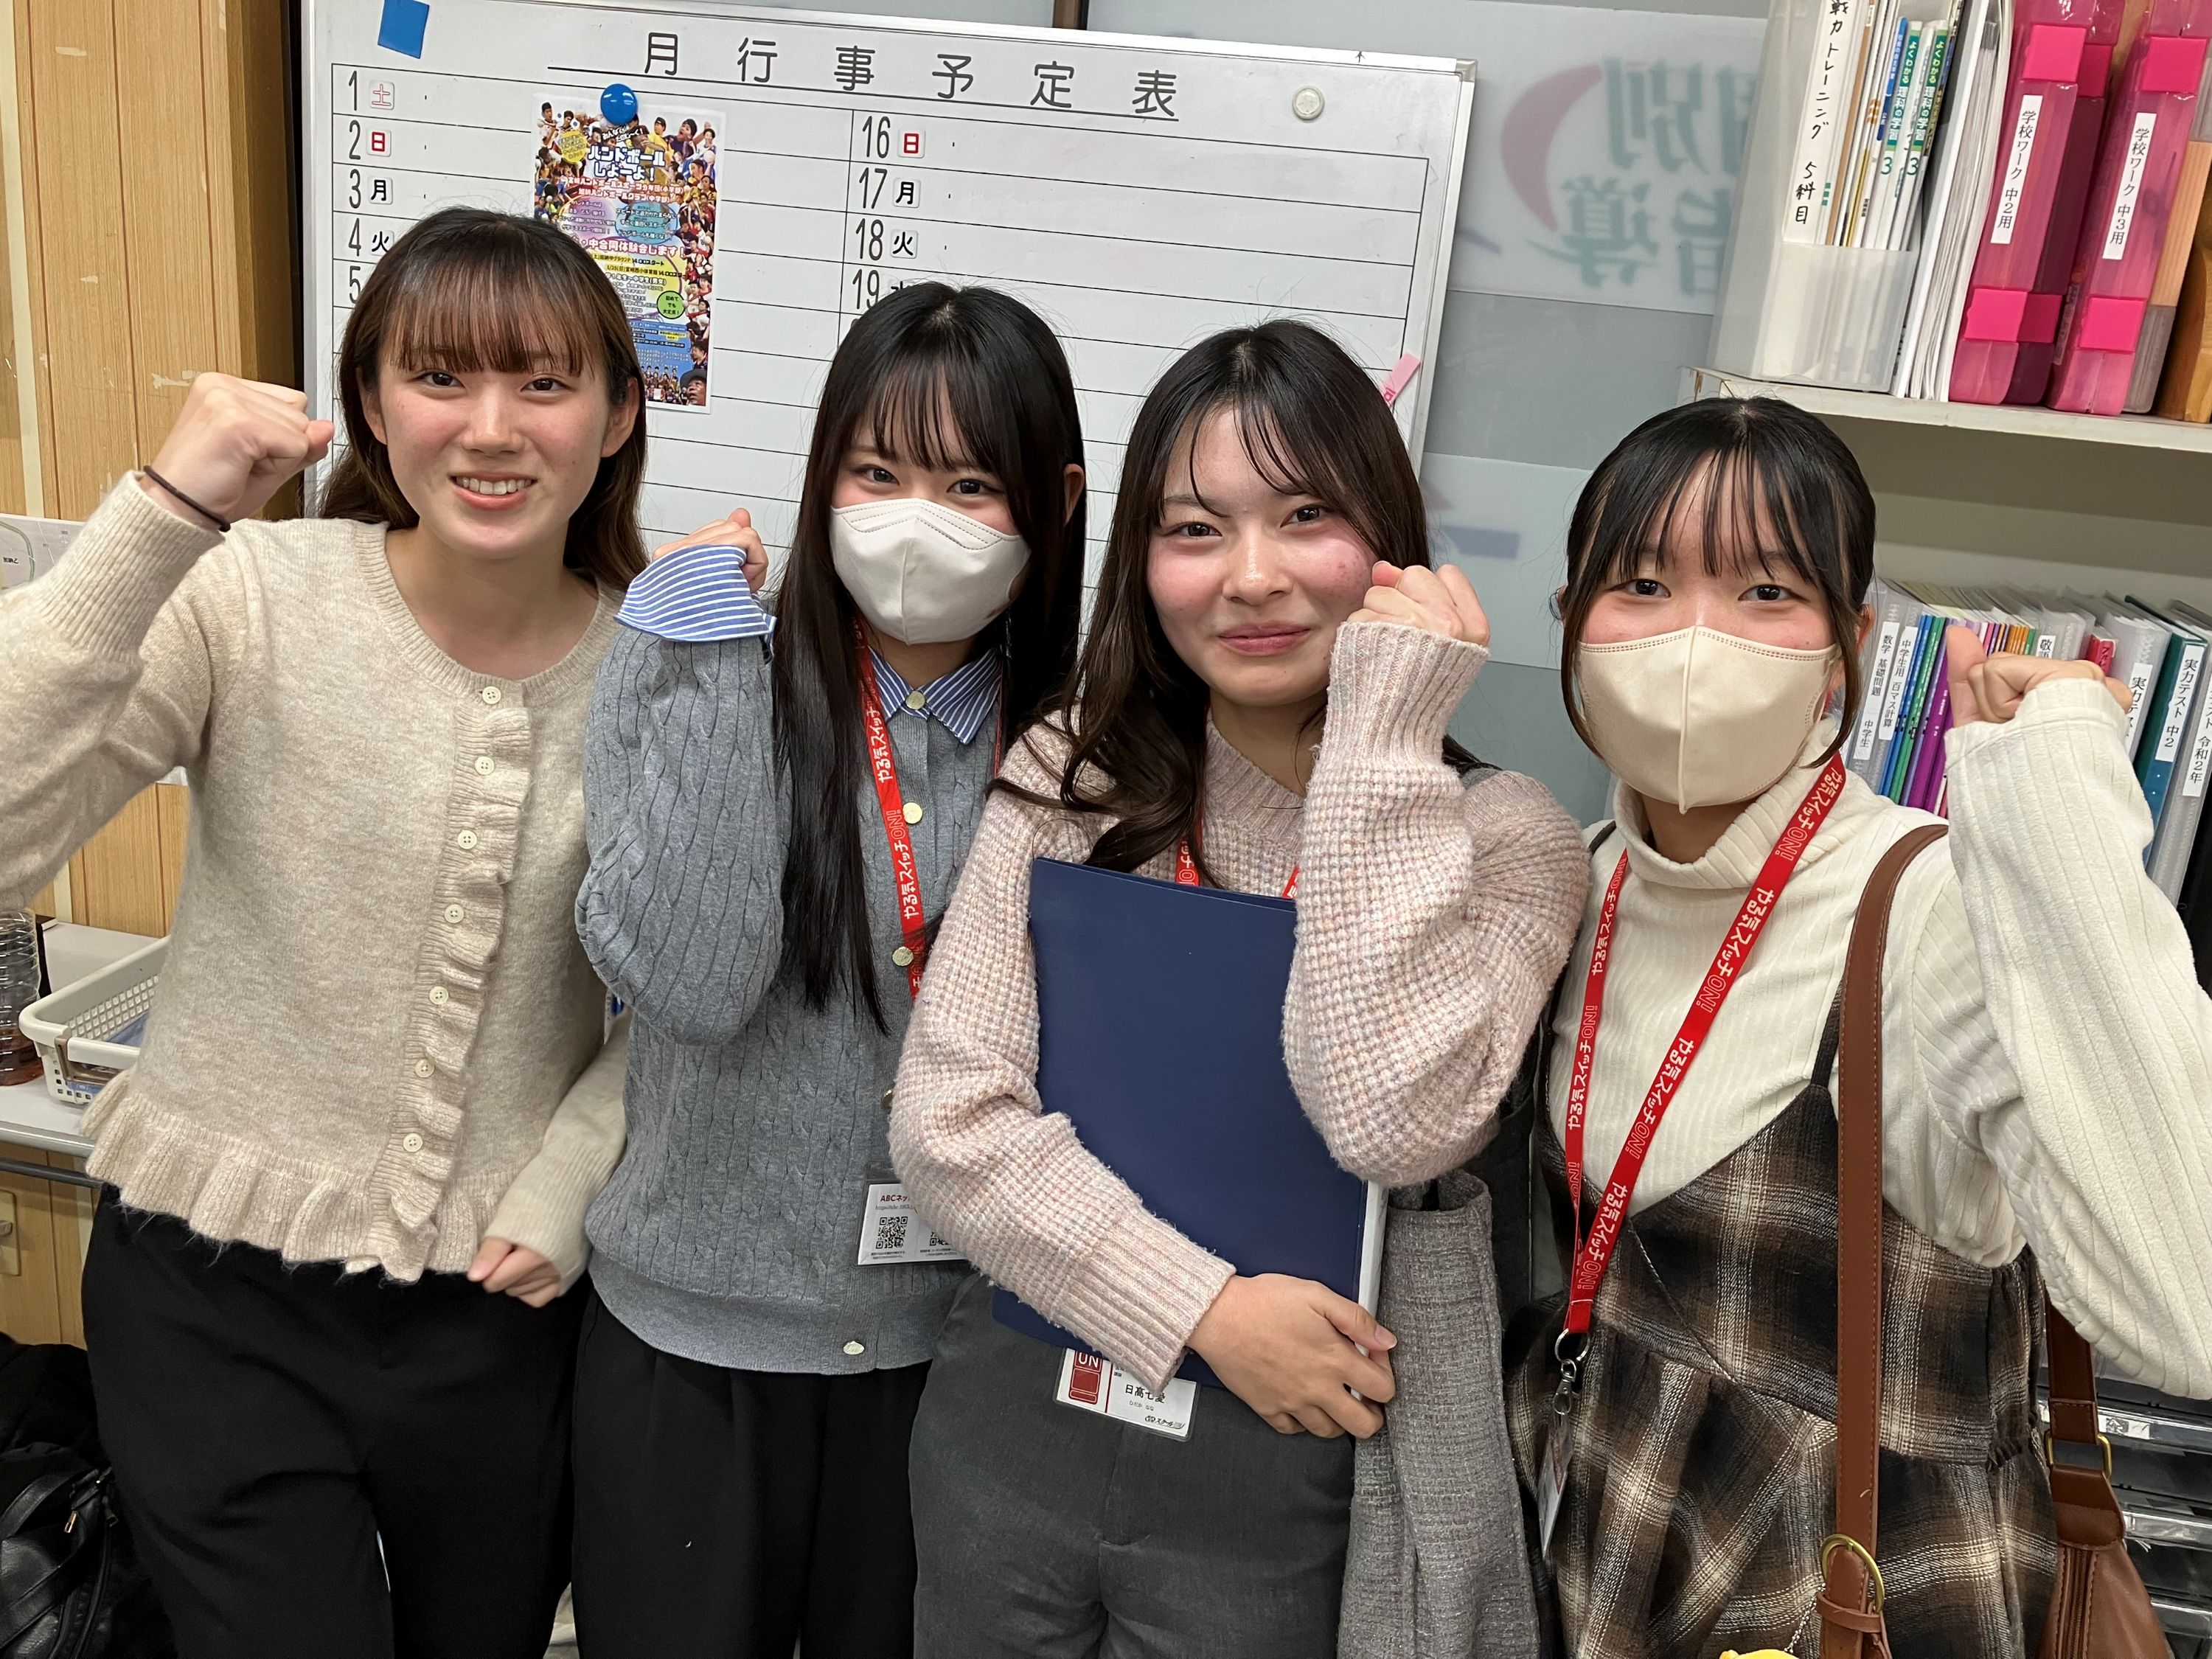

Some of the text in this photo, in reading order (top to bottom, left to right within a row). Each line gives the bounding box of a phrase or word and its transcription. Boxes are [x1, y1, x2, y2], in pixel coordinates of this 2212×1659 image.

[1902, 41, 1918, 84] よくわかる
[1929, 41, 1944, 84] よくわかる
[348, 70, 392, 111] 1 土
[349, 119, 386, 160] 2 日
[588, 145, 665, 167] ハンドボール
[862, 115, 919, 159] 16 日
[1881, 156, 1893, 175] 3
[1907, 157, 1919, 175] 3
[1997, 110, 2037, 229] 学校ワーク 中2用
[2110, 128, 2150, 245] 学校ワーク 中3用
[349, 168, 387, 209] 3 月
[858, 167, 914, 209] 17 月
[1795, 161, 1818, 225] 5科目
[348, 218, 389, 257] 4 火
[855, 218, 914, 261] 18 火
[349, 265, 361, 304] 5
[852, 268, 880, 310] 19
[1881, 635, 1894, 654] 数学
[1882, 639, 1911, 728] 中学生用 百マス計算
[2164, 658, 2199, 748] 実力テスト 中2
[1860, 720, 1874, 748] 中学生
[2188, 736, 2211, 784] 令和2年
[1696, 887, 1775, 1013] やる気スイッチON!
[1568, 1005, 1598, 1130] やる気スイッチON!
[1624, 1037, 1694, 1160] やる気スイッチON!
[880, 1194, 911, 1203] ABCネッ
[1576, 1181, 1628, 1290] やる気スイッチON!
